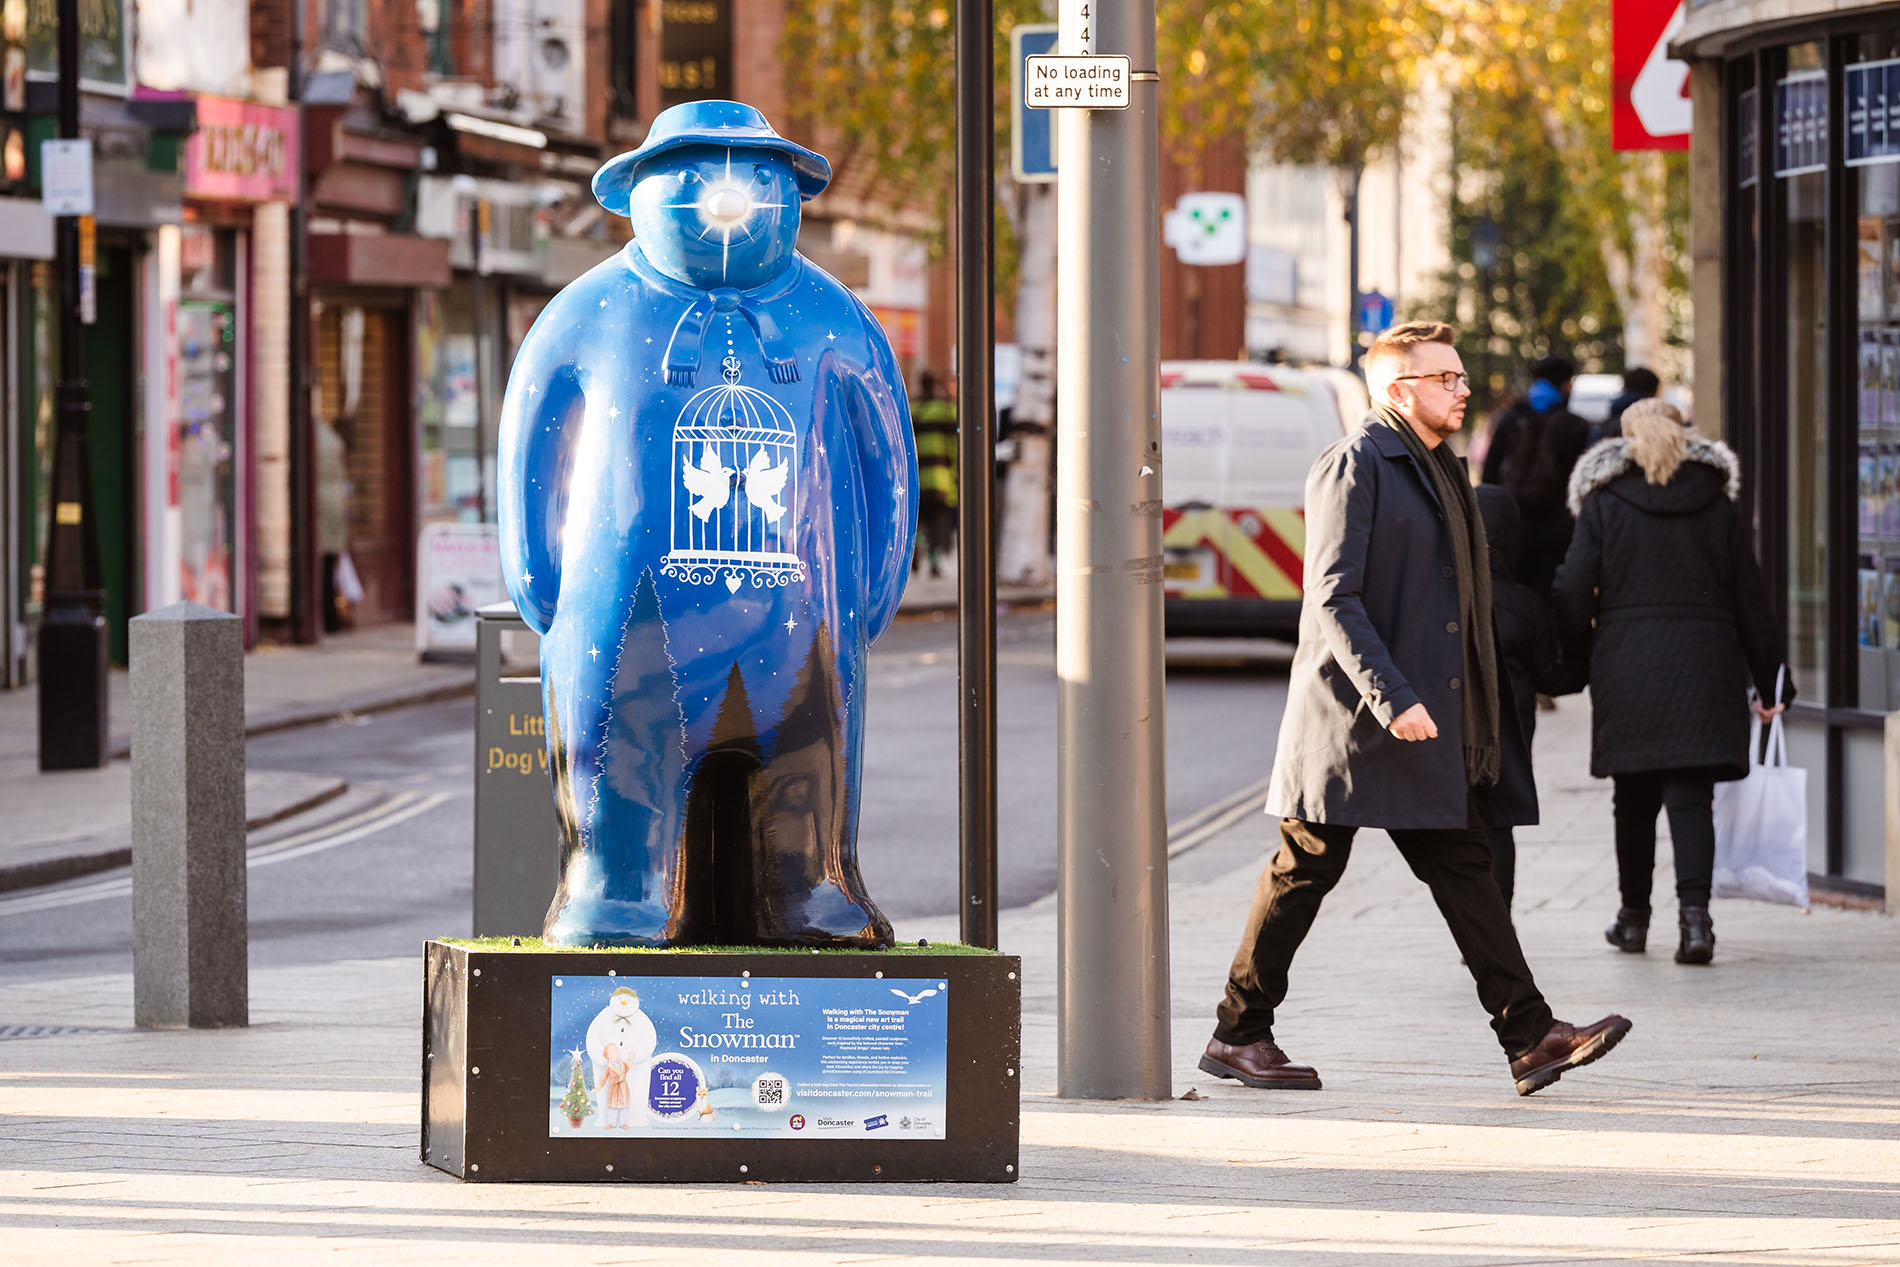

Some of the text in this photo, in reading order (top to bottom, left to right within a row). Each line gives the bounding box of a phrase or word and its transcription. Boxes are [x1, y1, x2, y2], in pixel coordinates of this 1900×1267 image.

[1036, 65, 1121, 81] No loading
[1034, 84, 1122, 100] at any time
[488, 747, 532, 775] Dog
[678, 989, 800, 1010] walking with
[822, 1008, 910, 1016] Walking with The Snowman
[722, 1013, 754, 1028] The
[710, 1054, 768, 1063] in Doncaster
[662, 1081, 680, 1096] 12
[796, 1089, 932, 1098] visitdoncaster.com/snowman-trail
